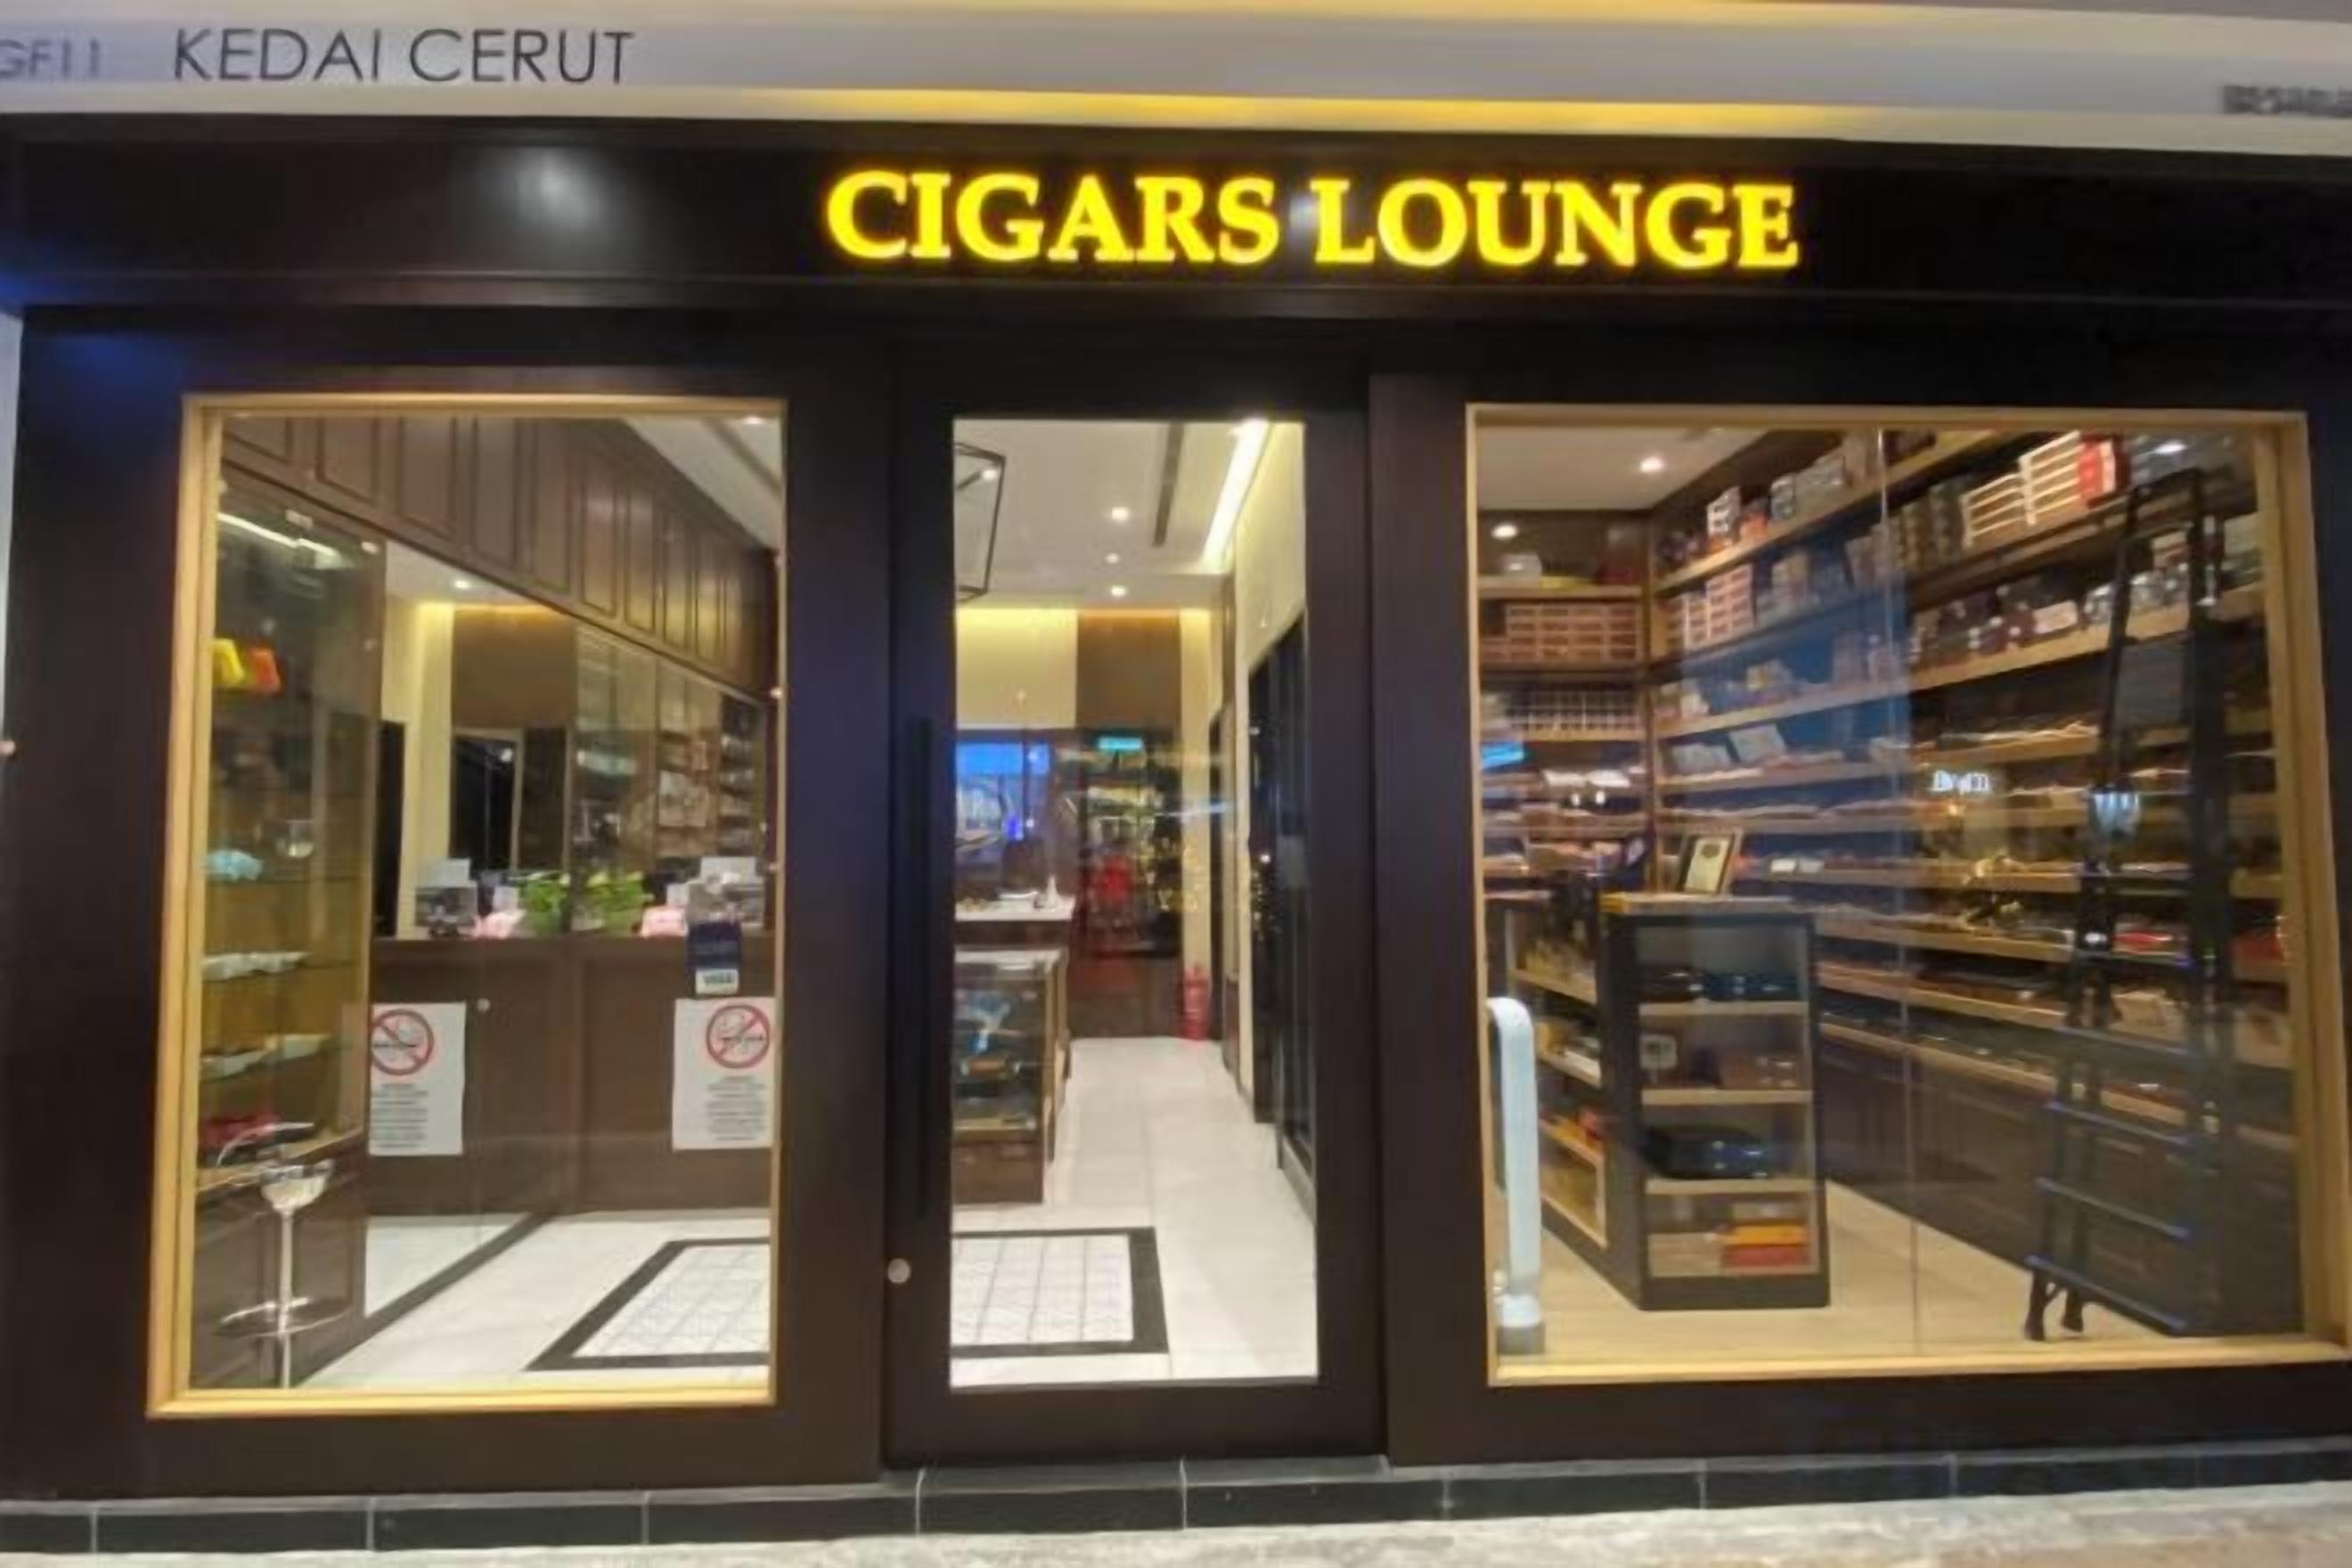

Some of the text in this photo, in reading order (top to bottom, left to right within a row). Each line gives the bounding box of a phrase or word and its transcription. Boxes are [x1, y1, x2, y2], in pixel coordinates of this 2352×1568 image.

[175, 29, 634, 84] KEDAI CERUT
[827, 169, 1799, 268] CIGARS LOUNGE
